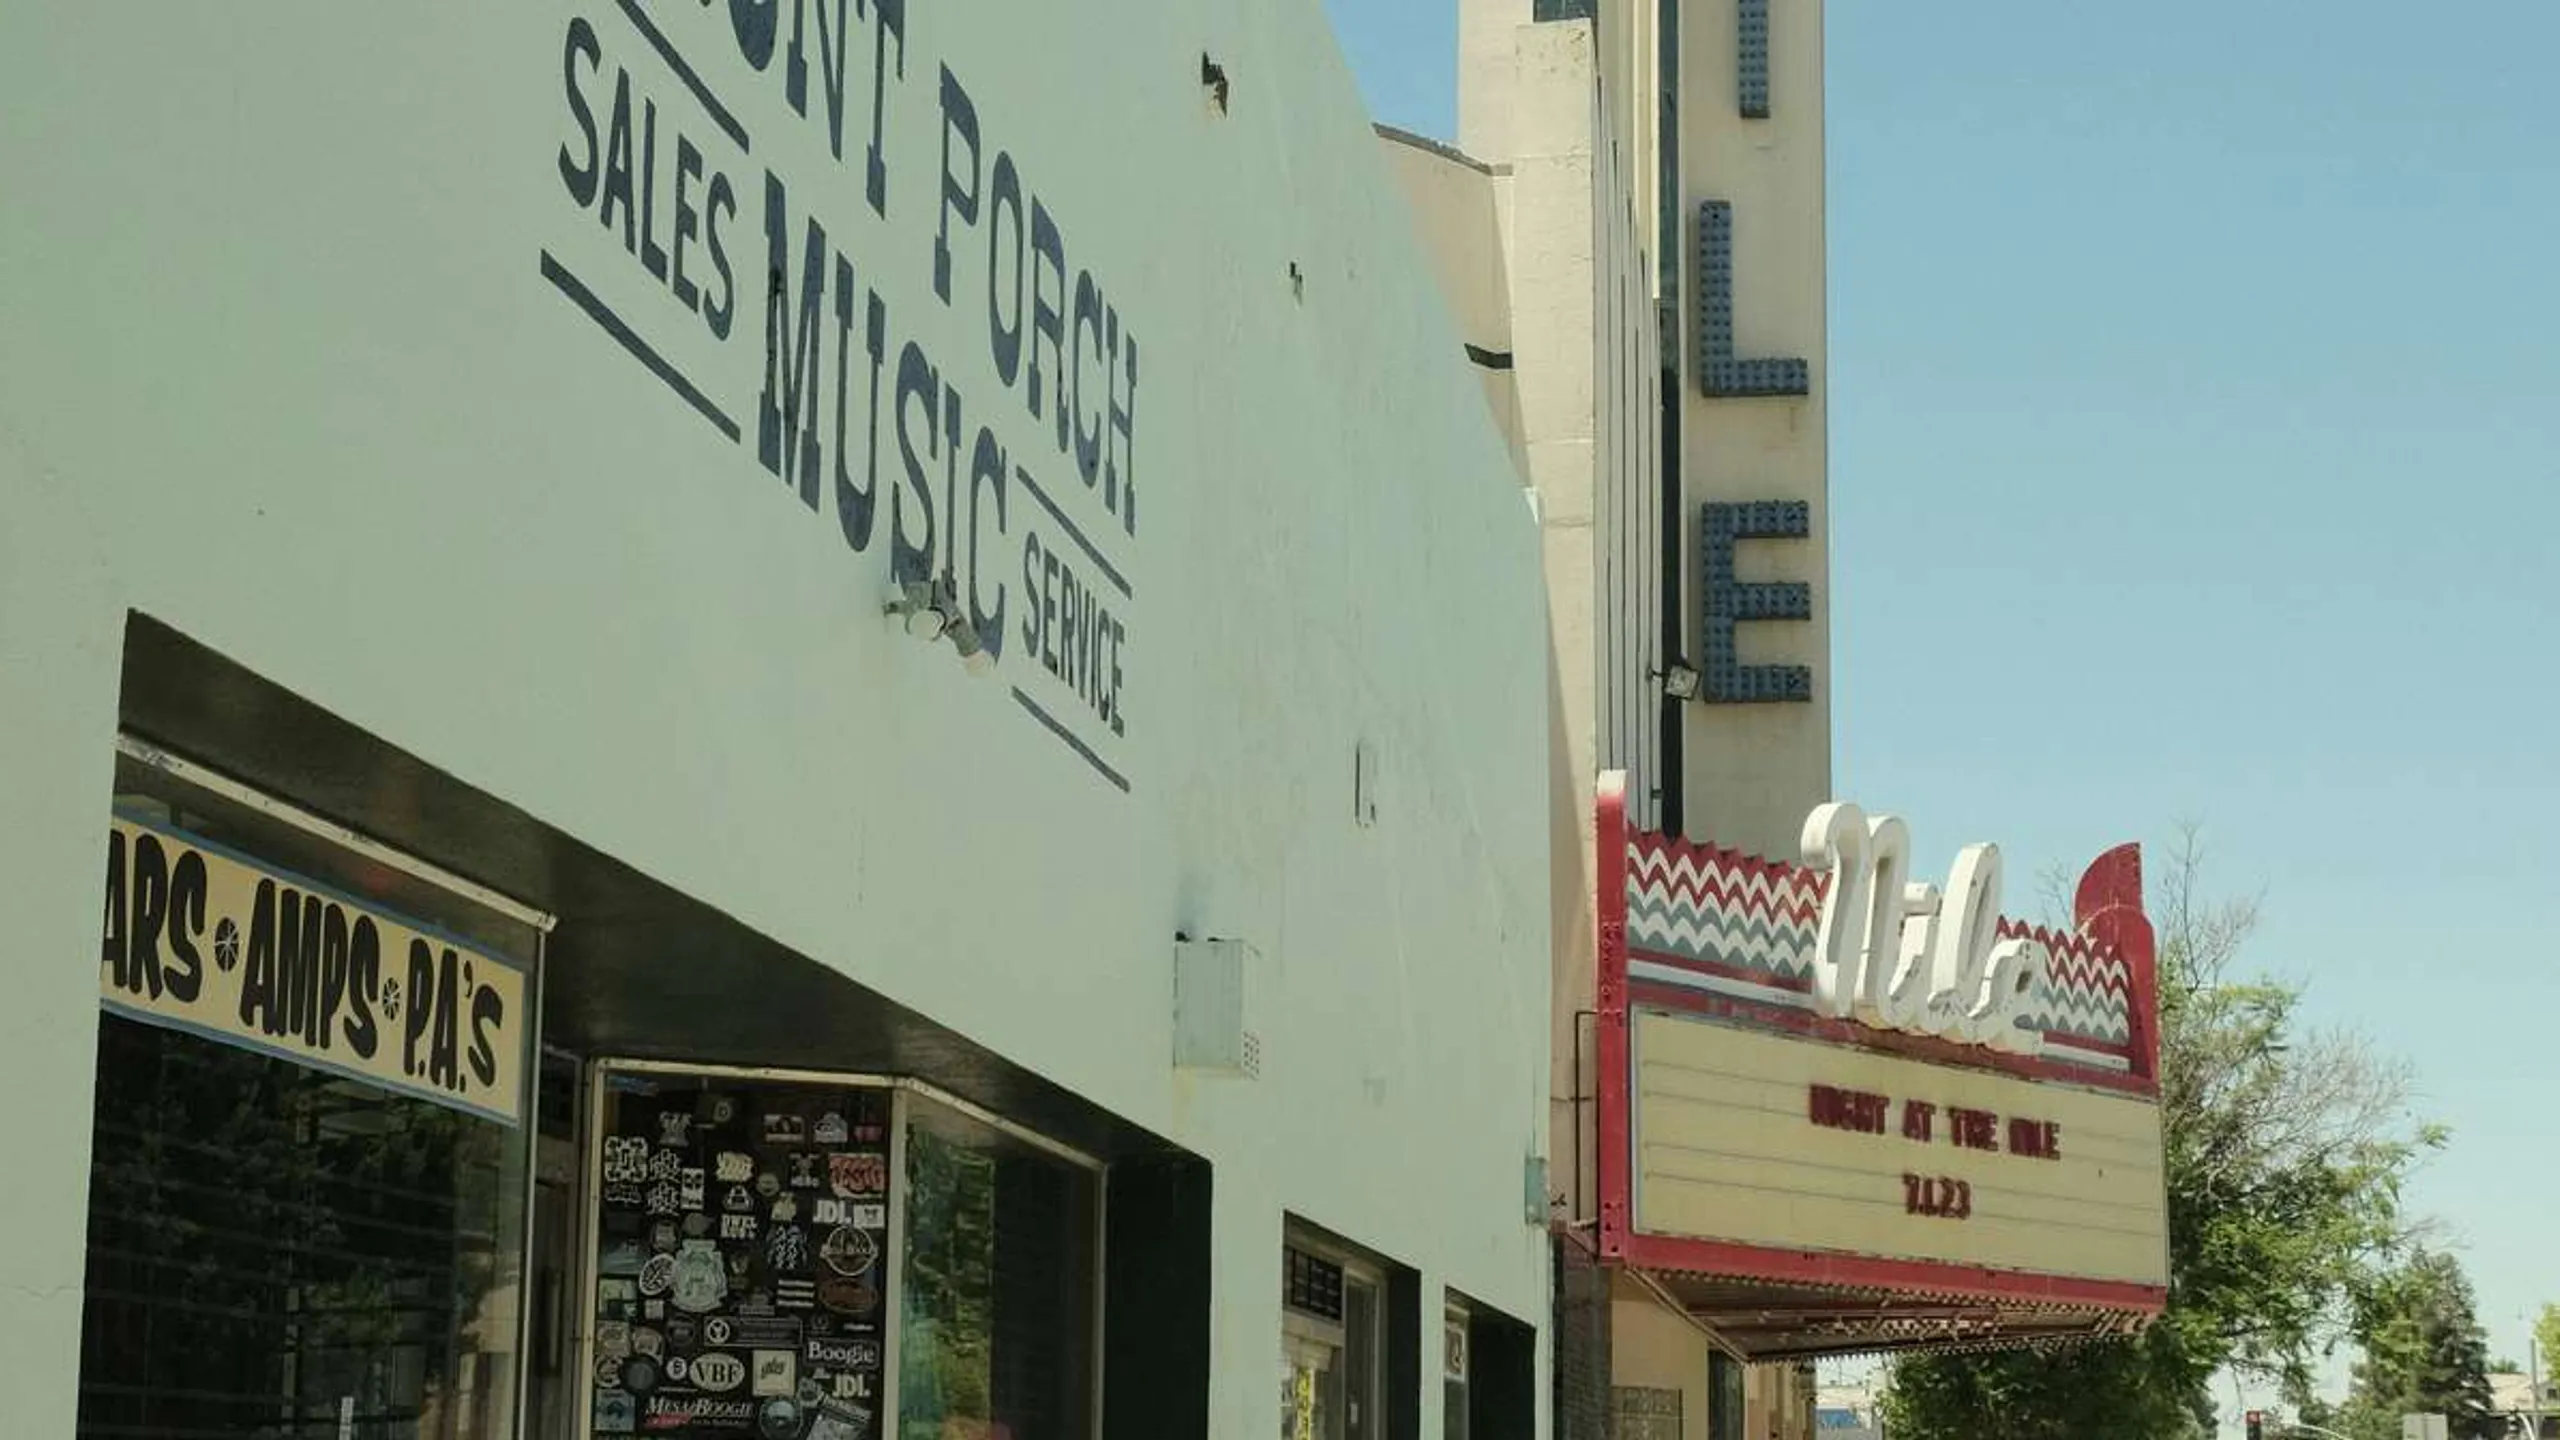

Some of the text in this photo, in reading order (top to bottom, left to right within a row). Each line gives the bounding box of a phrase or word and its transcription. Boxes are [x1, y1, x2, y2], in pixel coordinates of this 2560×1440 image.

[933, 60, 1138, 537] PORCH
[558, 17, 1126, 738] SALES MUSIC SERVICE
[239, 877, 380, 1060] AMPS
[1902, 1099, 1936, 1143] AT
[1948, 1105, 1999, 1152] THE
[695, 1363, 741, 1384] VBF
[808, 1341, 875, 1365] Boogie
